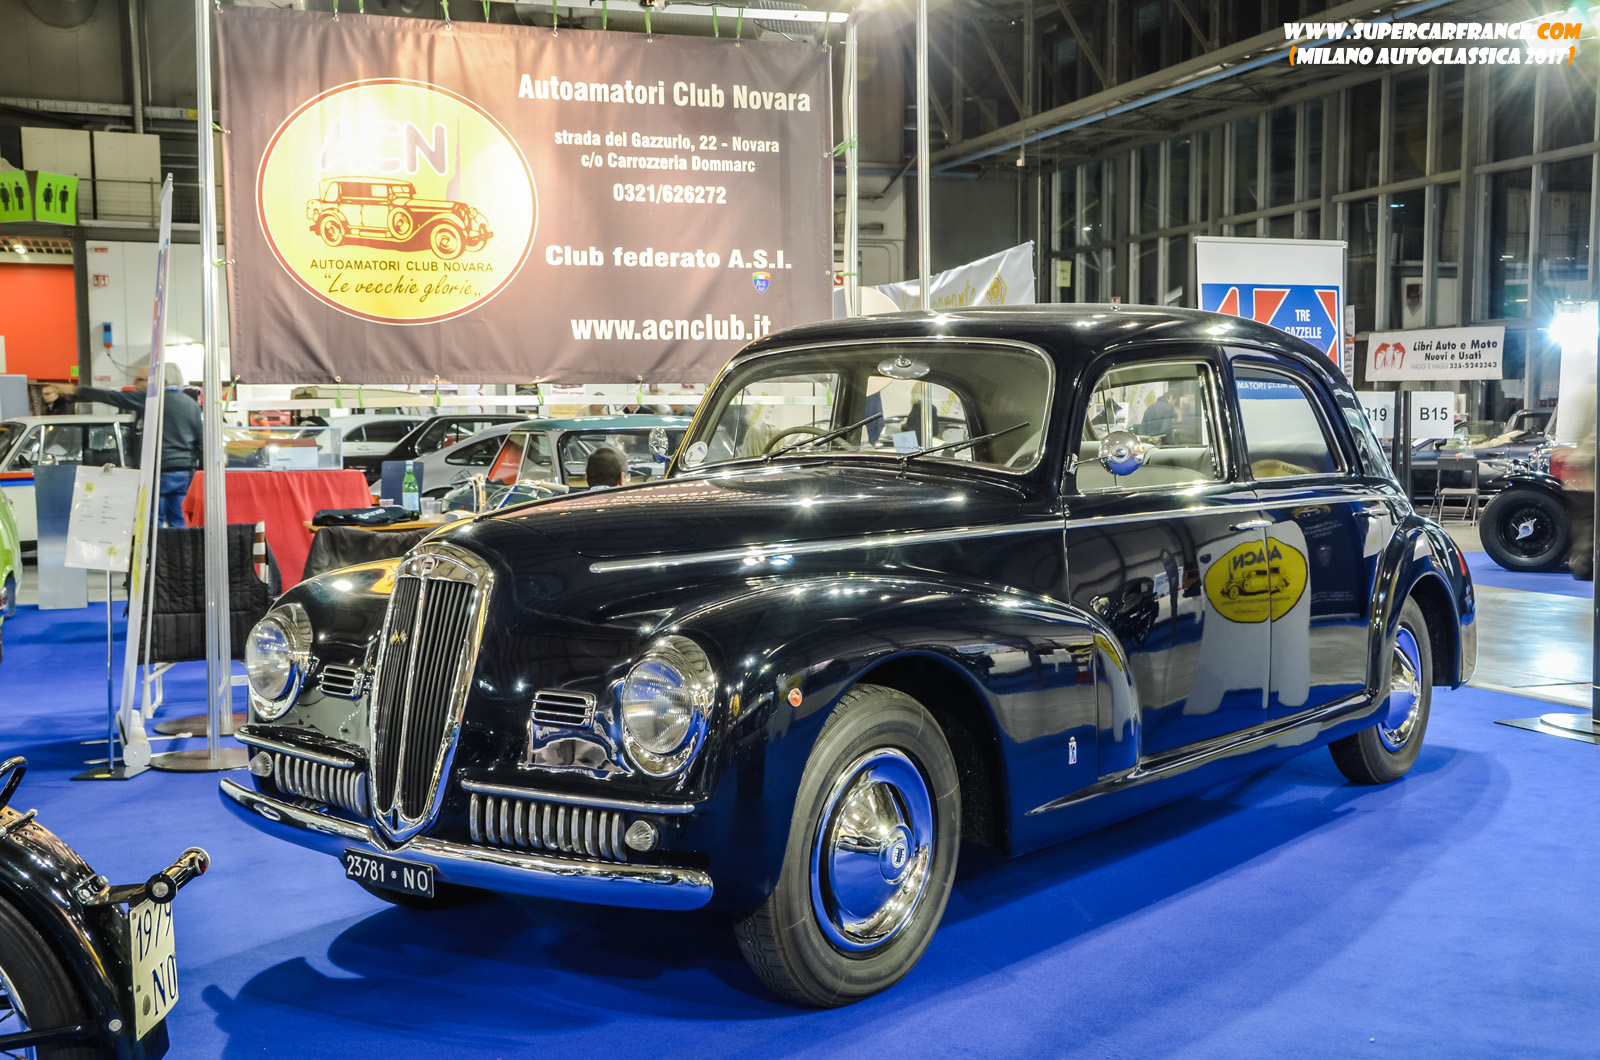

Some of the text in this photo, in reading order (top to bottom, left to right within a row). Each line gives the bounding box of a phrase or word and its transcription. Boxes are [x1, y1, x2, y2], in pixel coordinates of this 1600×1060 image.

[518, 74, 811, 112] Autoamatori Club Novara
[318, 117, 448, 176] ACN
[554, 130, 600, 146] strada
[605, 131, 627, 147] del
[699, 135, 717, 150] 22
[732, 136, 780, 153] Novara
[581, 152, 756, 173] c/o Carrozzeria Dommarc
[613, 183, 727, 205] 0321/626272
[310, 259, 494, 273] AUTOAMATORI CLUB NOVARA
[545, 245, 792, 269] Club federato A.S.I.
[355, 274, 417, 294] vecchie
[1295, 309, 1311, 322] TRE
[570, 313, 772, 341] www.acnclub.it
[1284, 326, 1322, 339] GAZZELLE
[1413, 339, 1498, 351] Libri Auto e Moto
[1425, 352, 1448, 361] Nuovi
[1458, 351, 1481, 360] Usati
[1420, 407, 1448, 422] B15
[347, 854, 428, 891] 23781 NO
[152, 954, 176, 1016] NO
